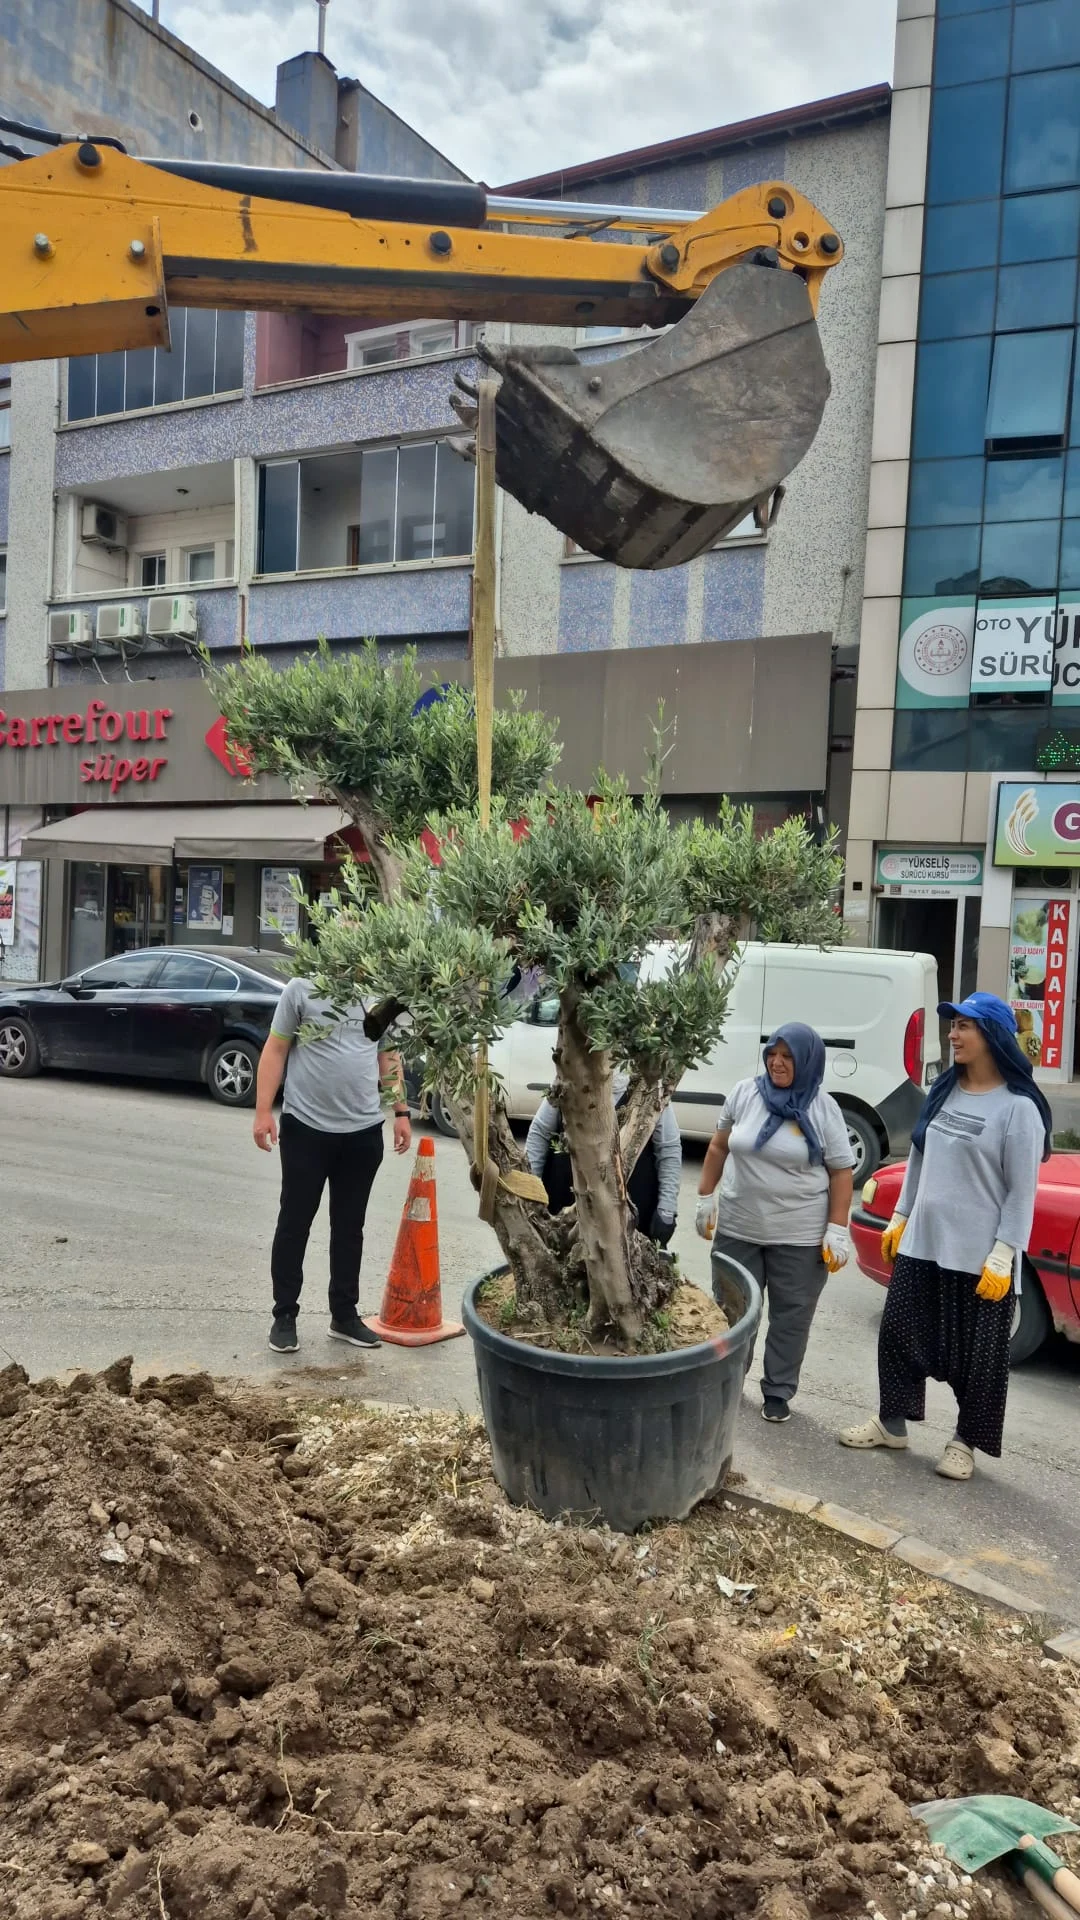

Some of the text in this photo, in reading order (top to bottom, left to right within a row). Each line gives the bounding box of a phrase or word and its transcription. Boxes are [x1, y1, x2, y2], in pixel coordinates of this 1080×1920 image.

[976, 618, 1011, 631] OTO
[79, 753, 168, 794] süper
[908, 856, 950, 870] YÜKSELİŞ
[1046, 903, 1066, 1064] KADAYIF
